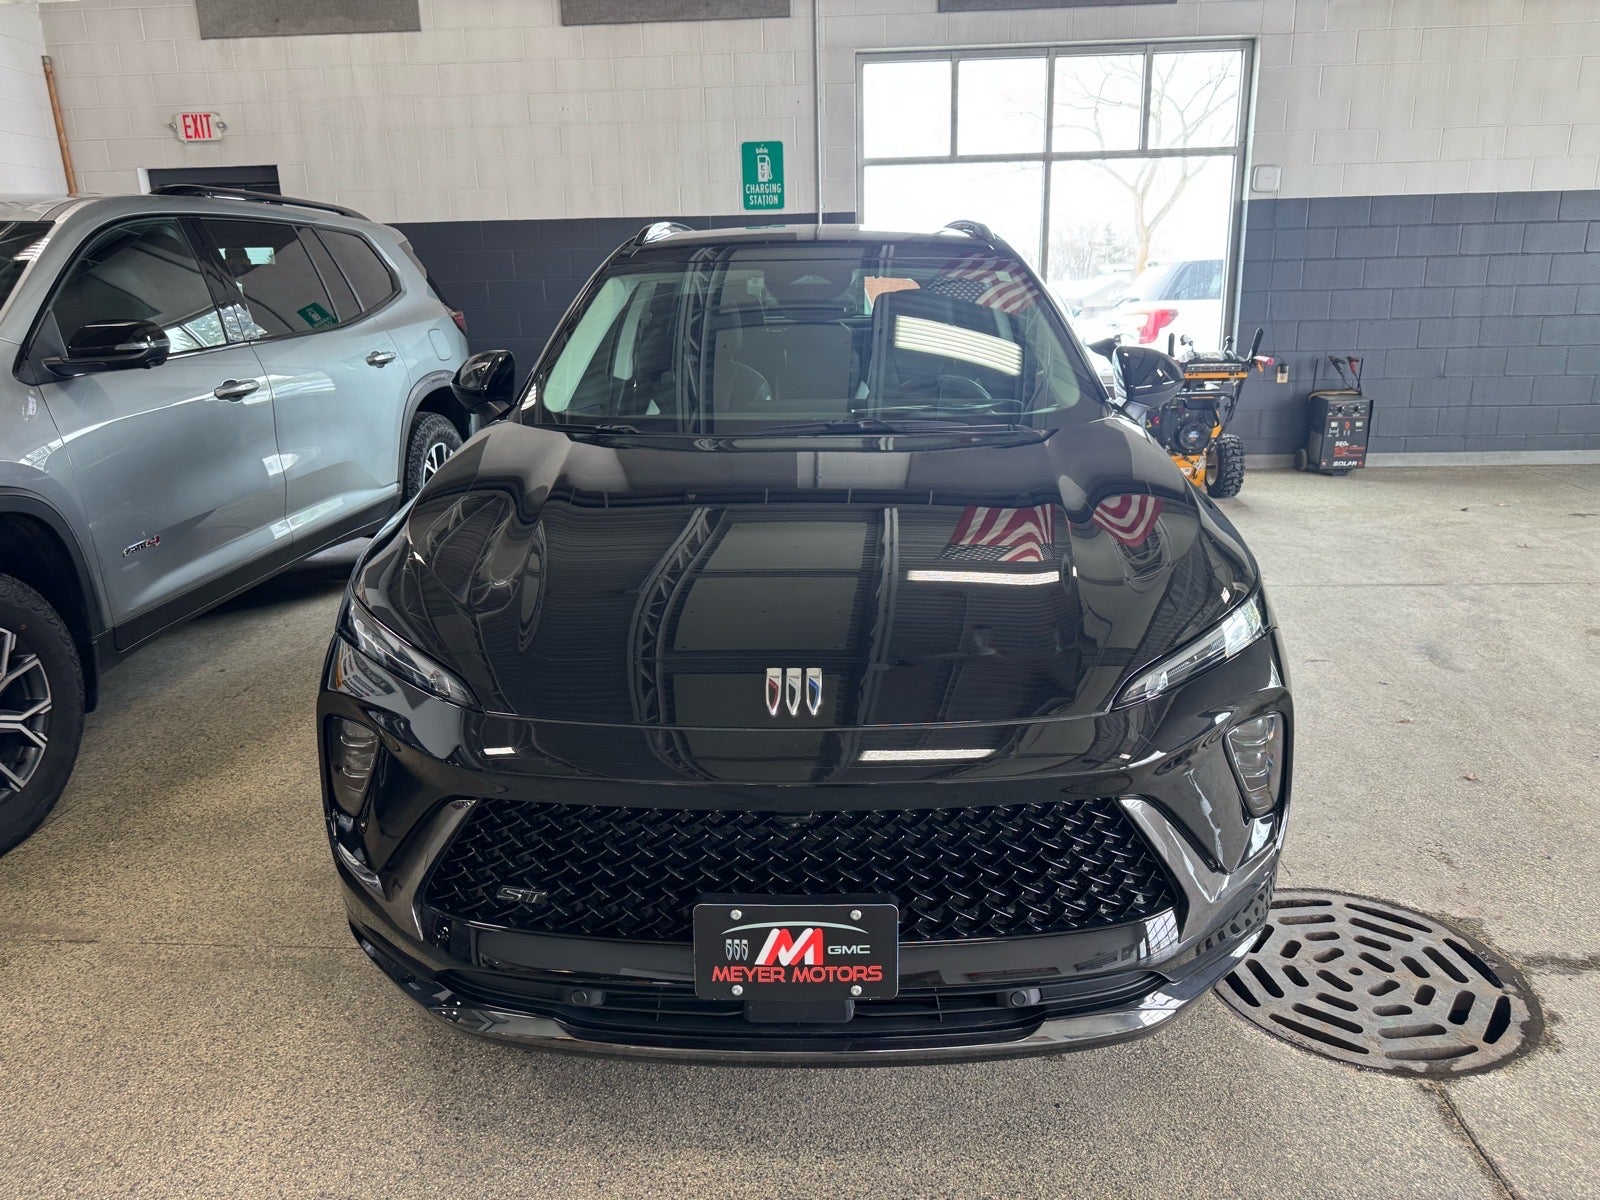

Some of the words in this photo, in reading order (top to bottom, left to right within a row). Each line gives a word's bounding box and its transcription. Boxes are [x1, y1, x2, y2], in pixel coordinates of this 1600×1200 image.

[182, 113, 212, 139] EXIT
[745, 183, 782, 194] CHARGING
[749, 194, 779, 206] STATION
[497, 885, 548, 903] ST
[827, 944, 871, 955] GMC
[711, 965, 786, 983] MEYER
[792, 965, 883, 983] MOTORS
